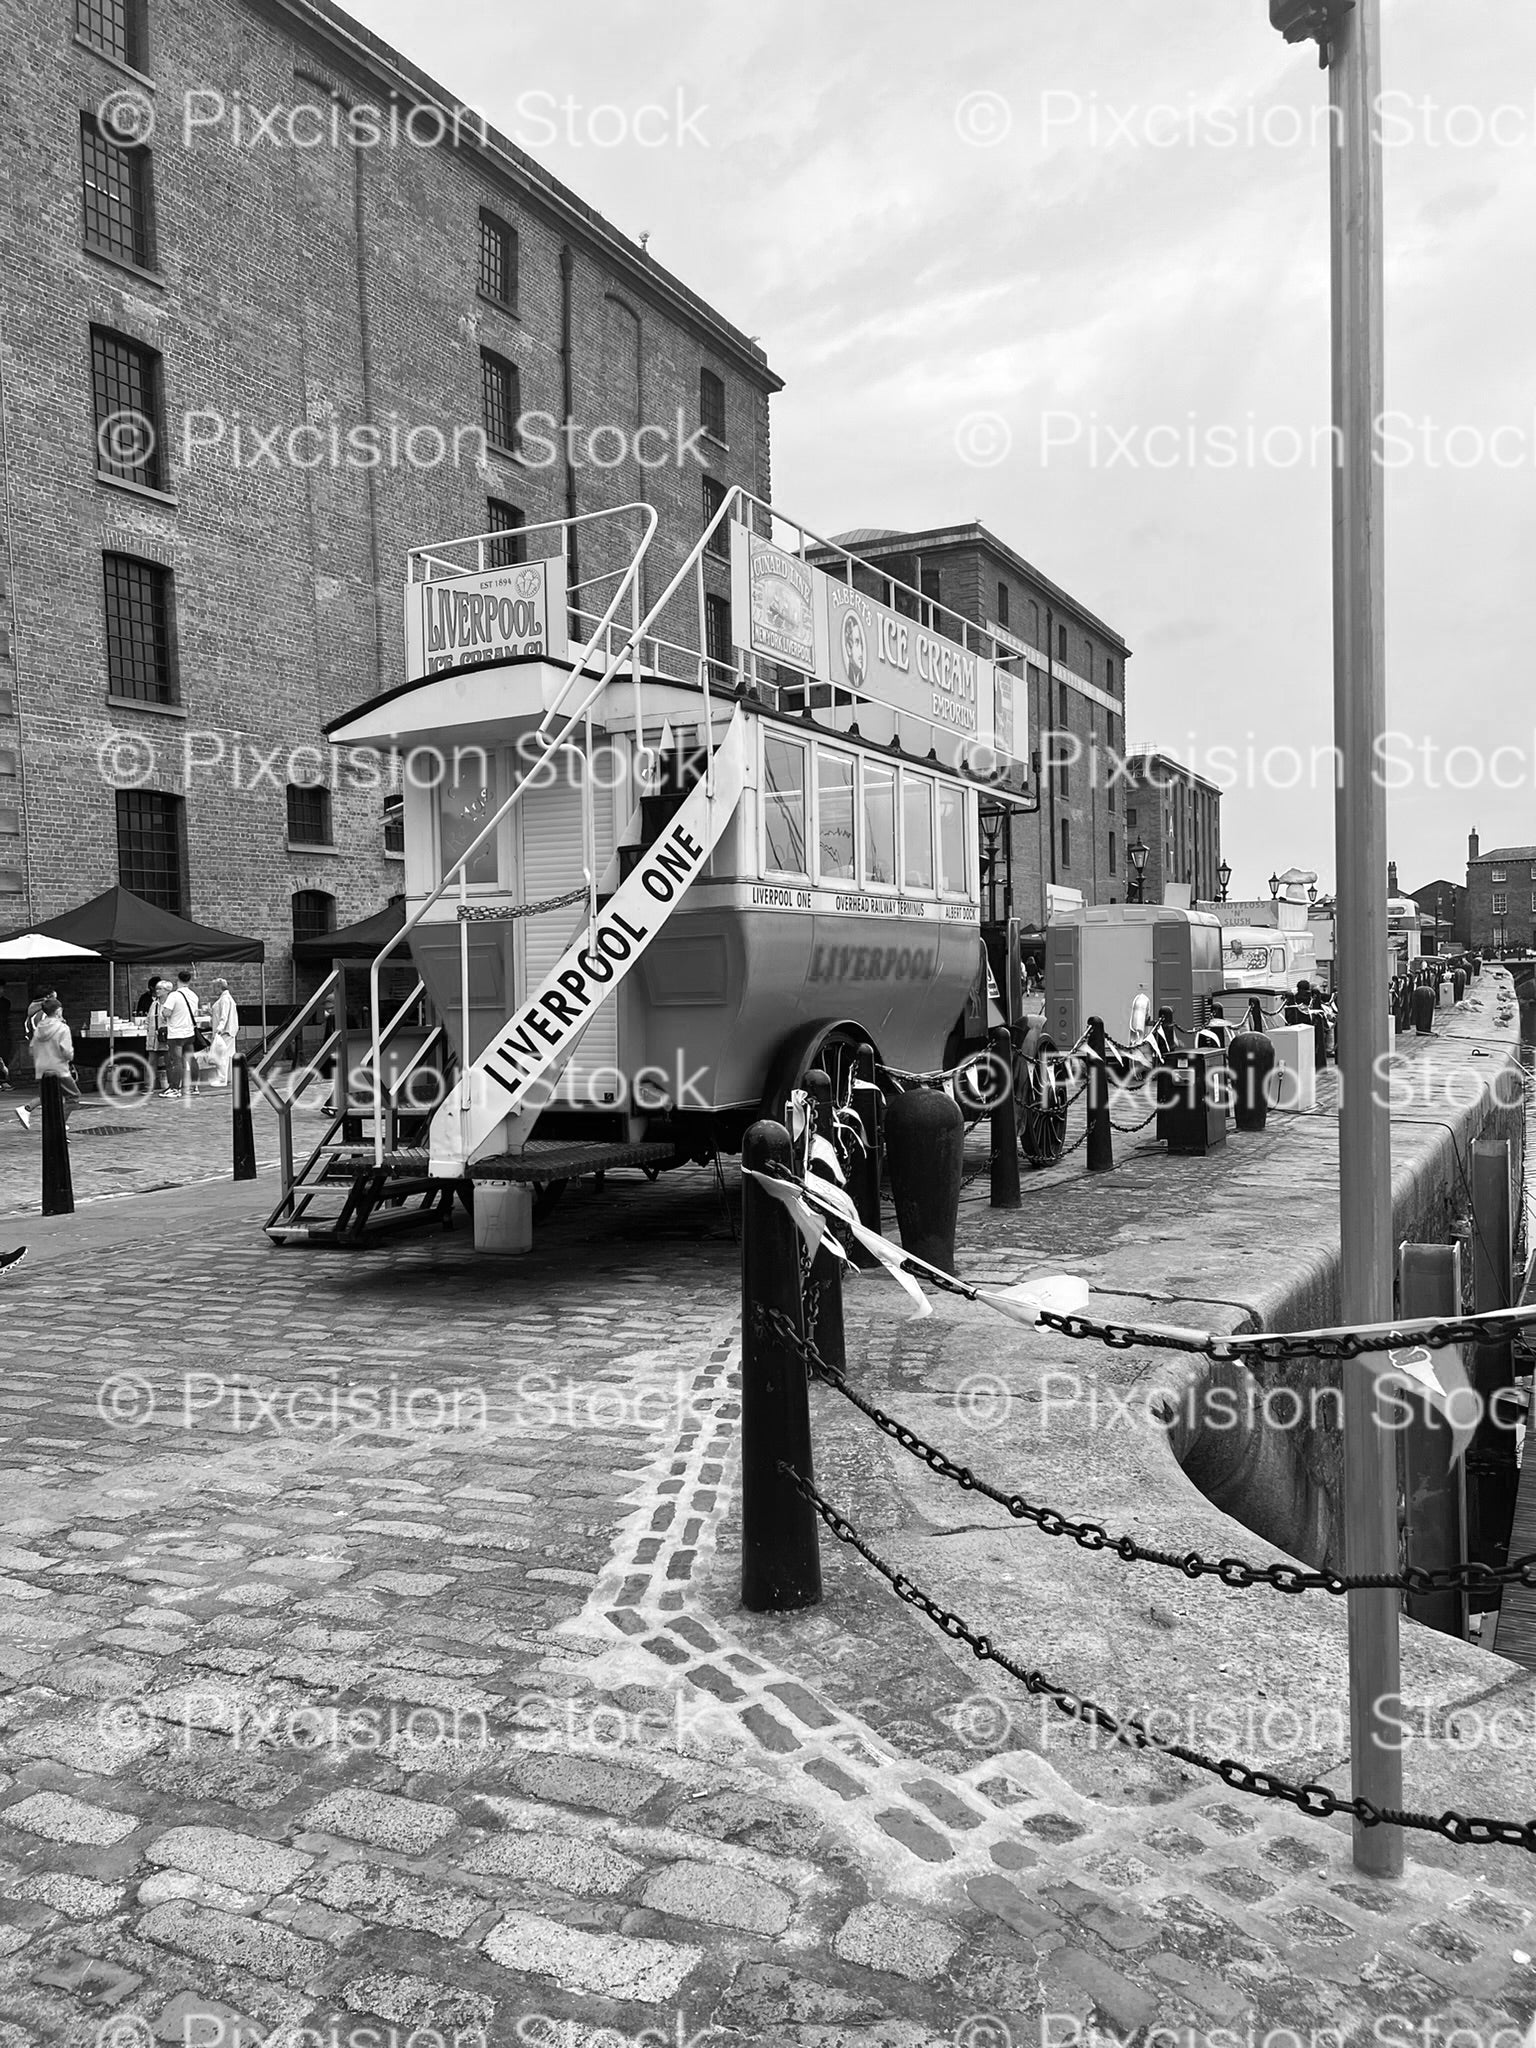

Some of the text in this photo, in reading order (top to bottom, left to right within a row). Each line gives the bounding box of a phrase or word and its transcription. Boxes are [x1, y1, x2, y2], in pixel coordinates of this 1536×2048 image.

[480, 581, 492, 589] EST
[426, 587, 543, 652] LIVERPOOL
[832, 588, 871, 626] ALBERT'S
[876, 612, 910, 671] ICE
[916, 634, 976, 703] CREAM
[932, 693, 976, 731] EMPORIUM
[752, 887, 812, 909] LIVERPOOL ONE
[835, 896, 925, 917] OVERHEAD RAILWAY TERMINUS
[1209, 902, 1266, 910] CANDYFLOSS
[945, 906, 976, 921] ALBERT DOCK
[1224, 918, 1251, 926] SLUSH
[483, 824, 703, 1094] LIVERPOOL ONE
[808, 944, 935, 982] LIVERPOOL
